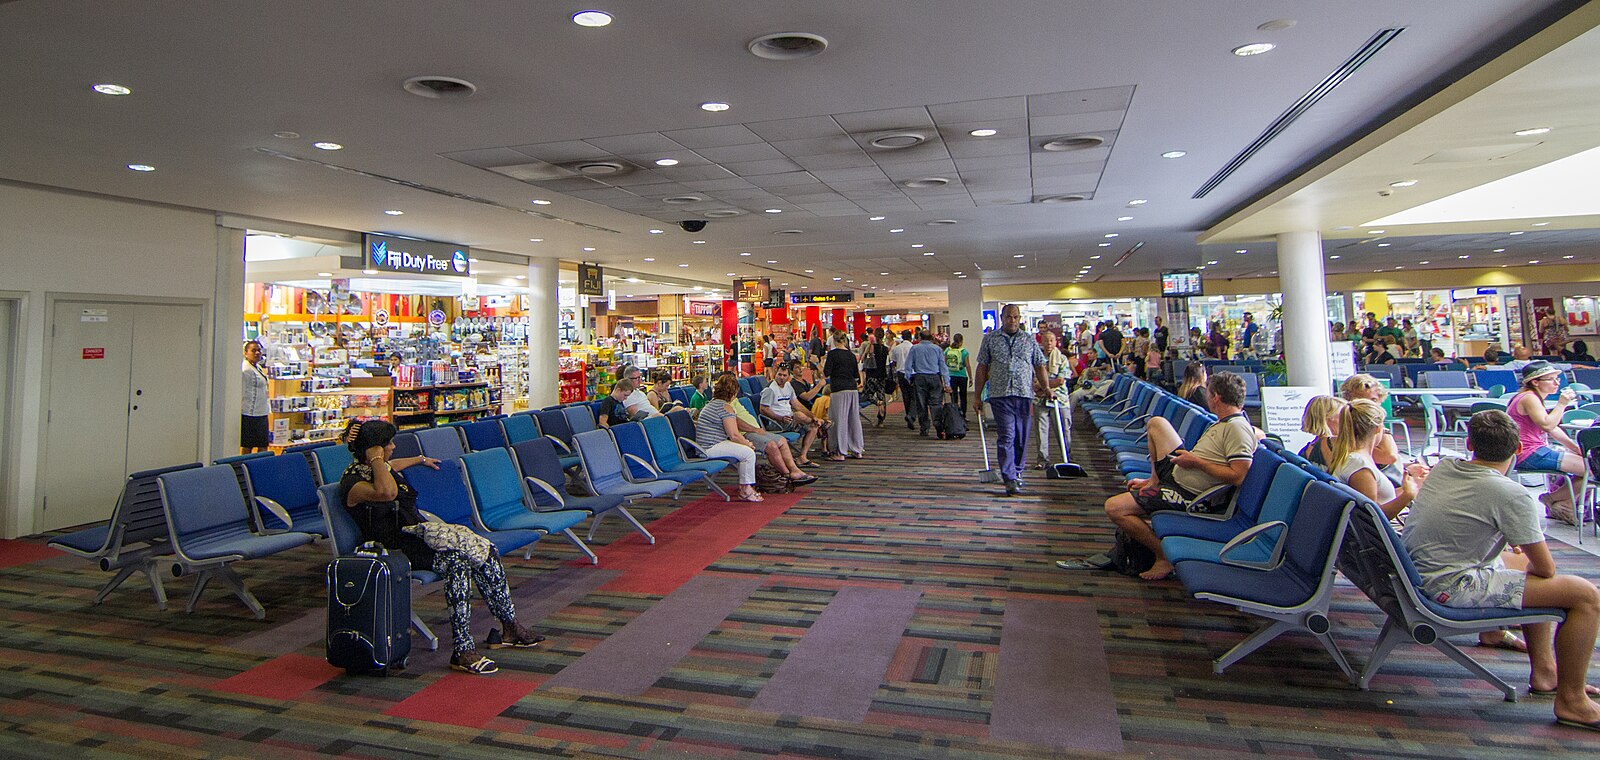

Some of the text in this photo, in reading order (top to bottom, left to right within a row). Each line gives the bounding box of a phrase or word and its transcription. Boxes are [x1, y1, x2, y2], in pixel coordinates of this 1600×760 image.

[387, 250, 449, 272] Fiji Duty Free
[584, 280, 601, 290] FIJI
[738, 290, 763, 298] FIJI
